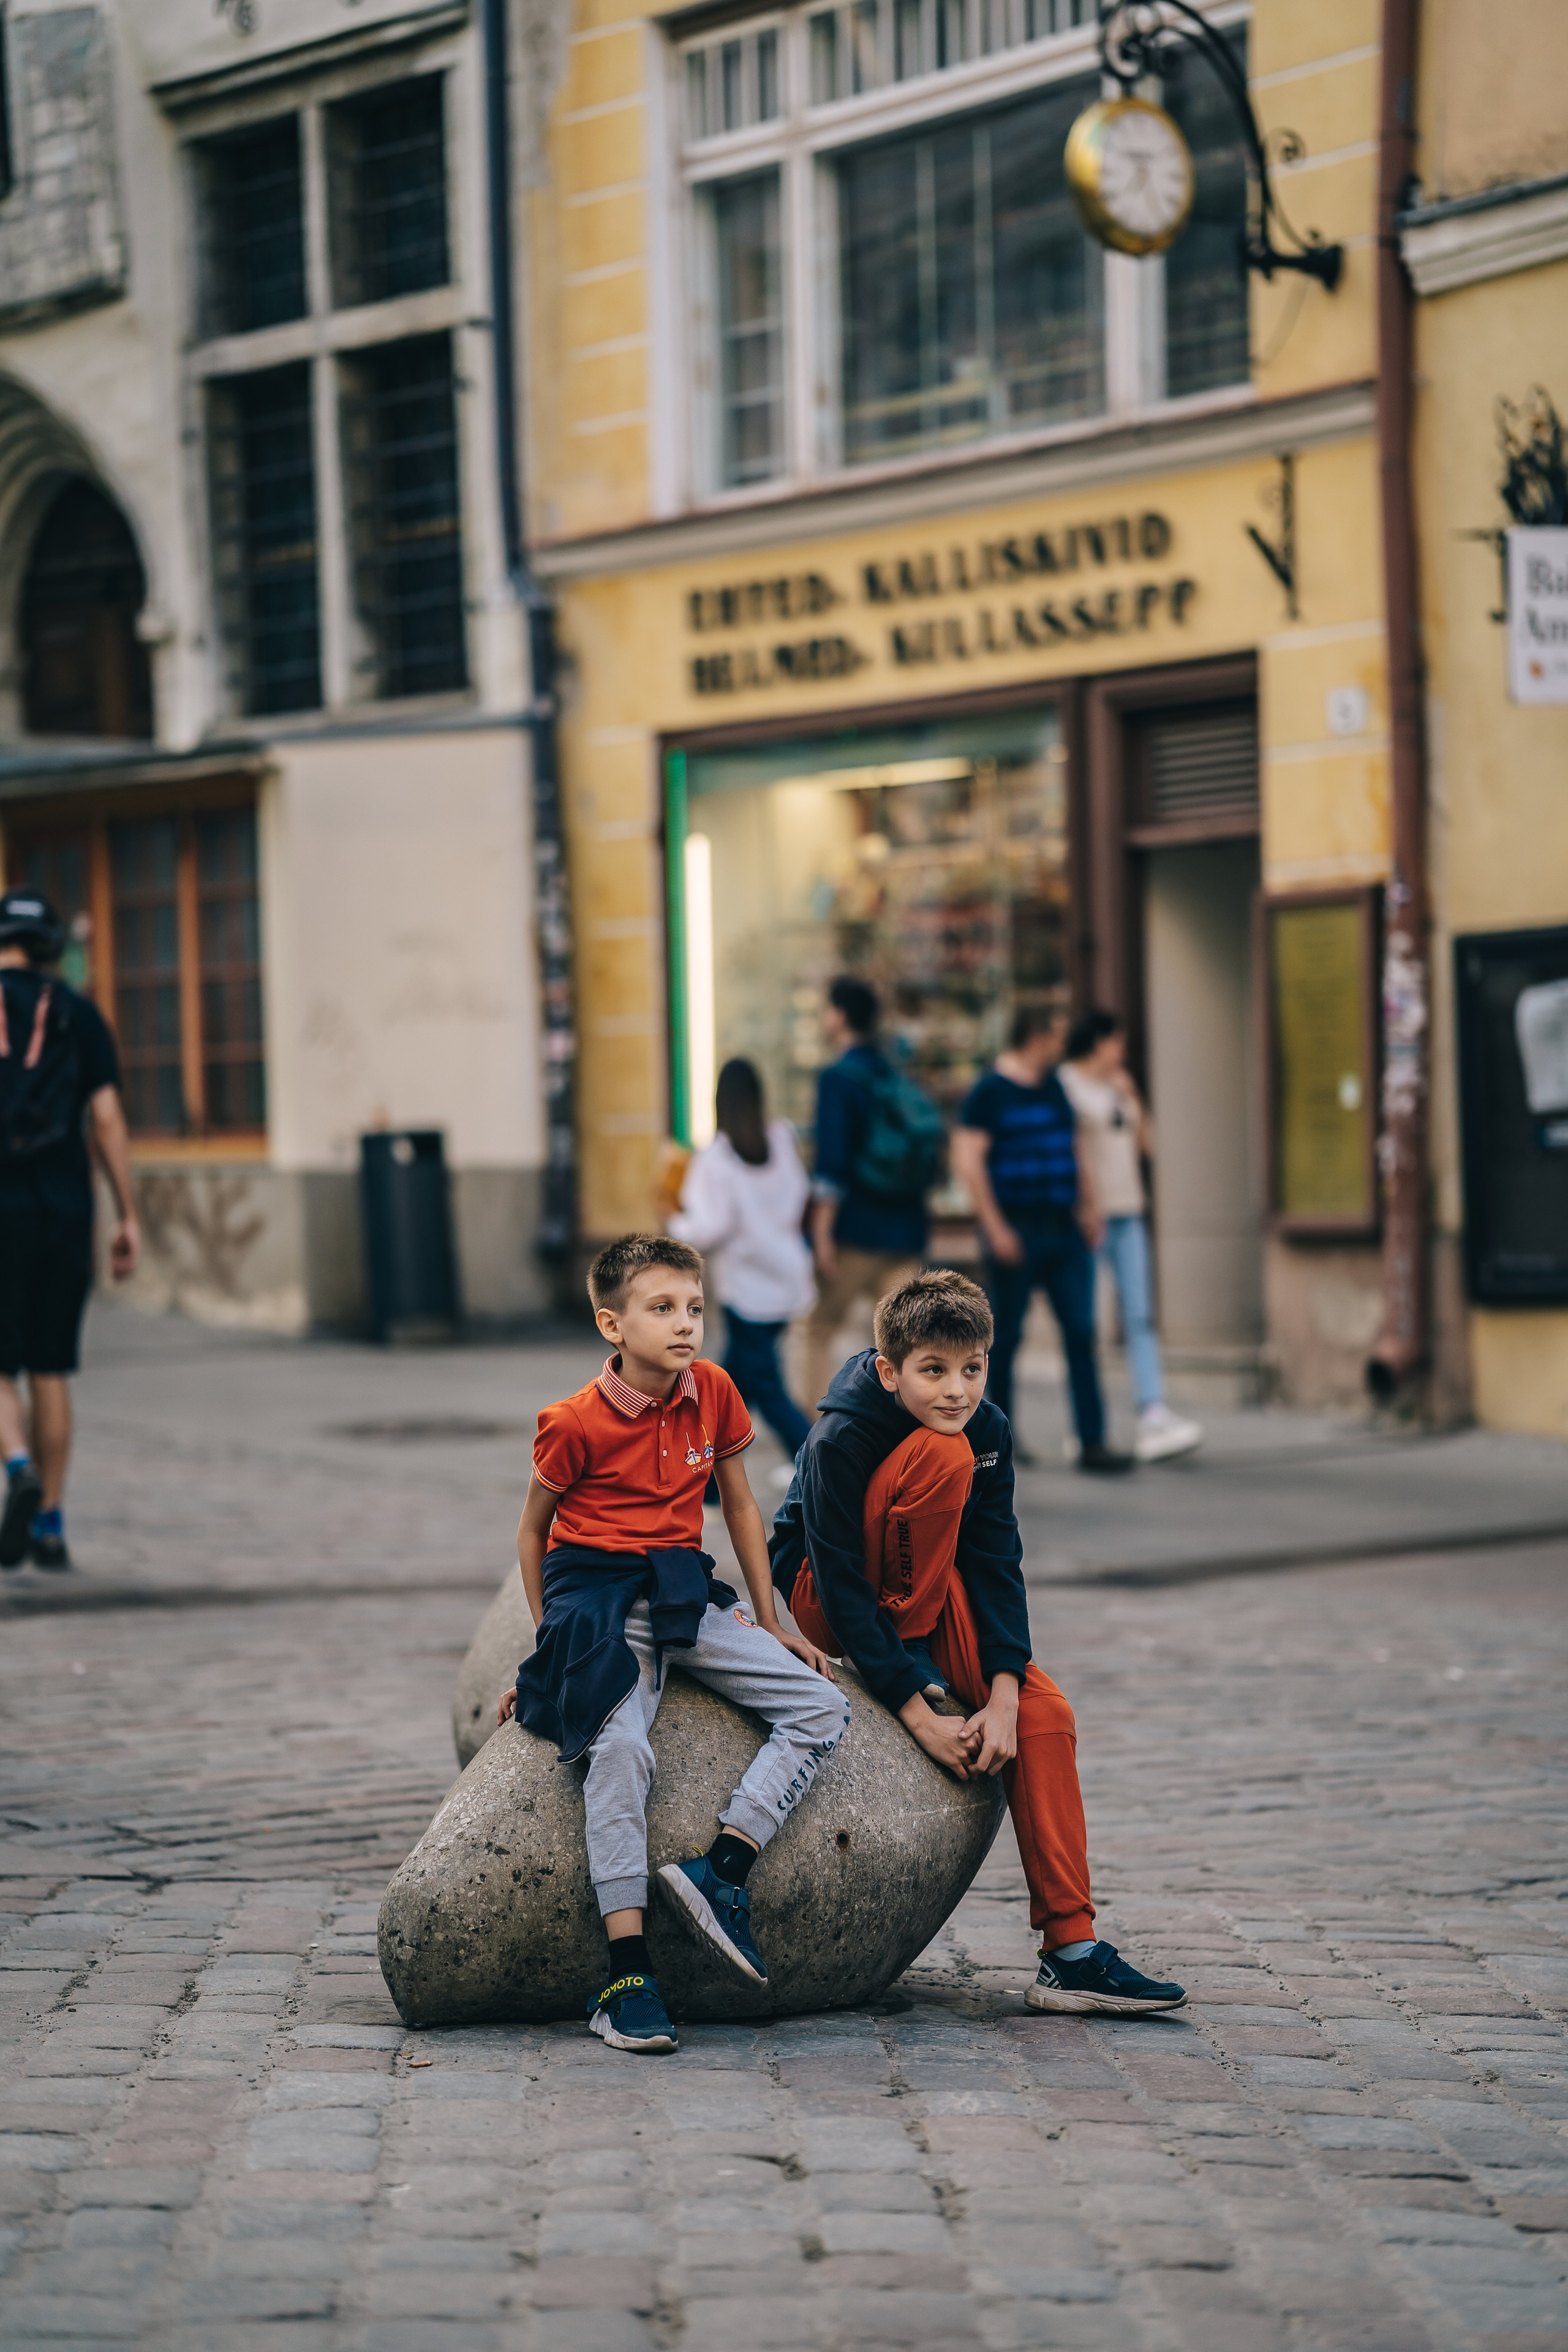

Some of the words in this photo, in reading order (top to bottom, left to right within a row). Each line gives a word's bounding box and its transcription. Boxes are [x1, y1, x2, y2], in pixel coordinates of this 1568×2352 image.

[980, 1451, 998, 1461] YOUR
[982, 1459, 997, 1468] SELF
[897, 1518, 910, 1548] TRUE
[900, 1552, 913, 1580] SELF
[889, 1581, 913, 1608] TRUE
[777, 1740, 835, 1811] SURFING
[598, 1976, 644, 2003] JOMOTO
